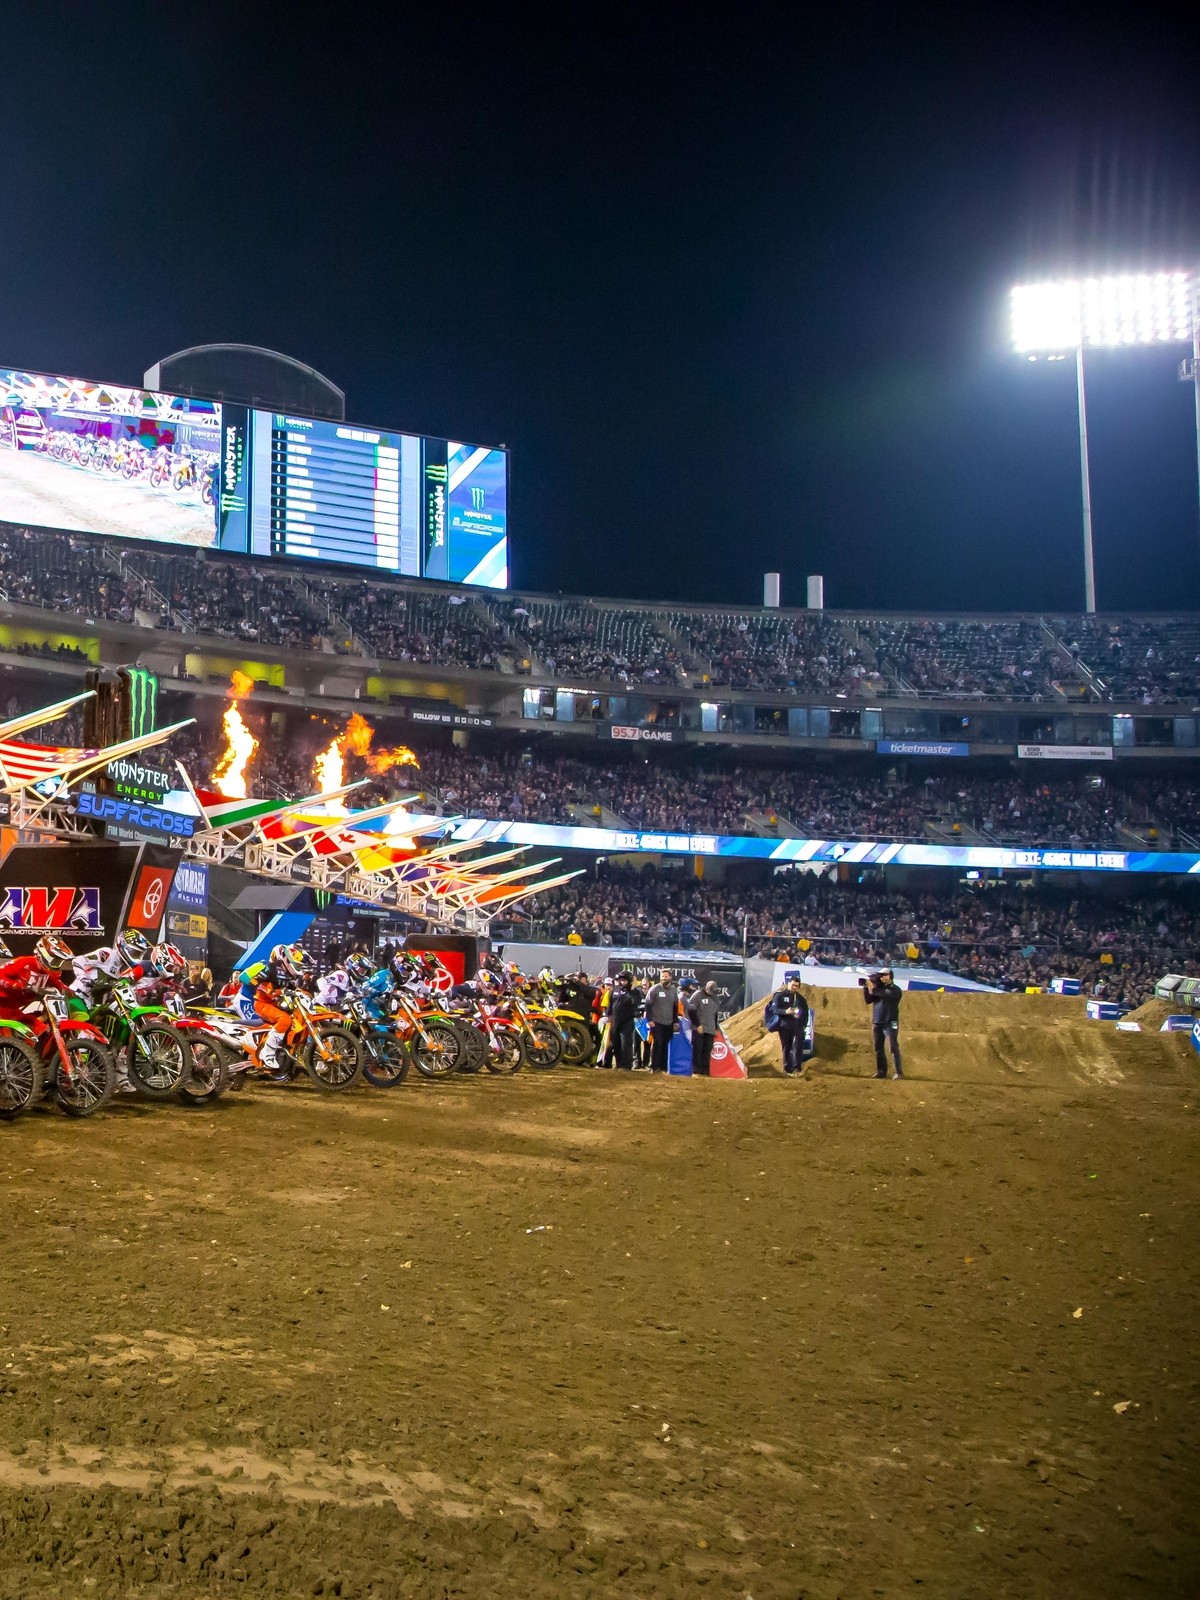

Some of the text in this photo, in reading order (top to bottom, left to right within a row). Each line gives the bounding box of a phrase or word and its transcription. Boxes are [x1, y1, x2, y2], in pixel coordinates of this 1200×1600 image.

[225, 426, 237, 491] MONSTER
[435, 485, 445, 548] MONSTER
[413, 712, 451, 722] FOLLOW US
[613, 727, 672, 741] 95.7 GAME
[890, 742, 953, 754] ticketmaster
[107, 760, 170, 790] MONSTER
[82, 782, 97, 794] AMA
[116, 784, 164, 801] ENERGY
[77, 793, 195, 837] SUPERCROSS
